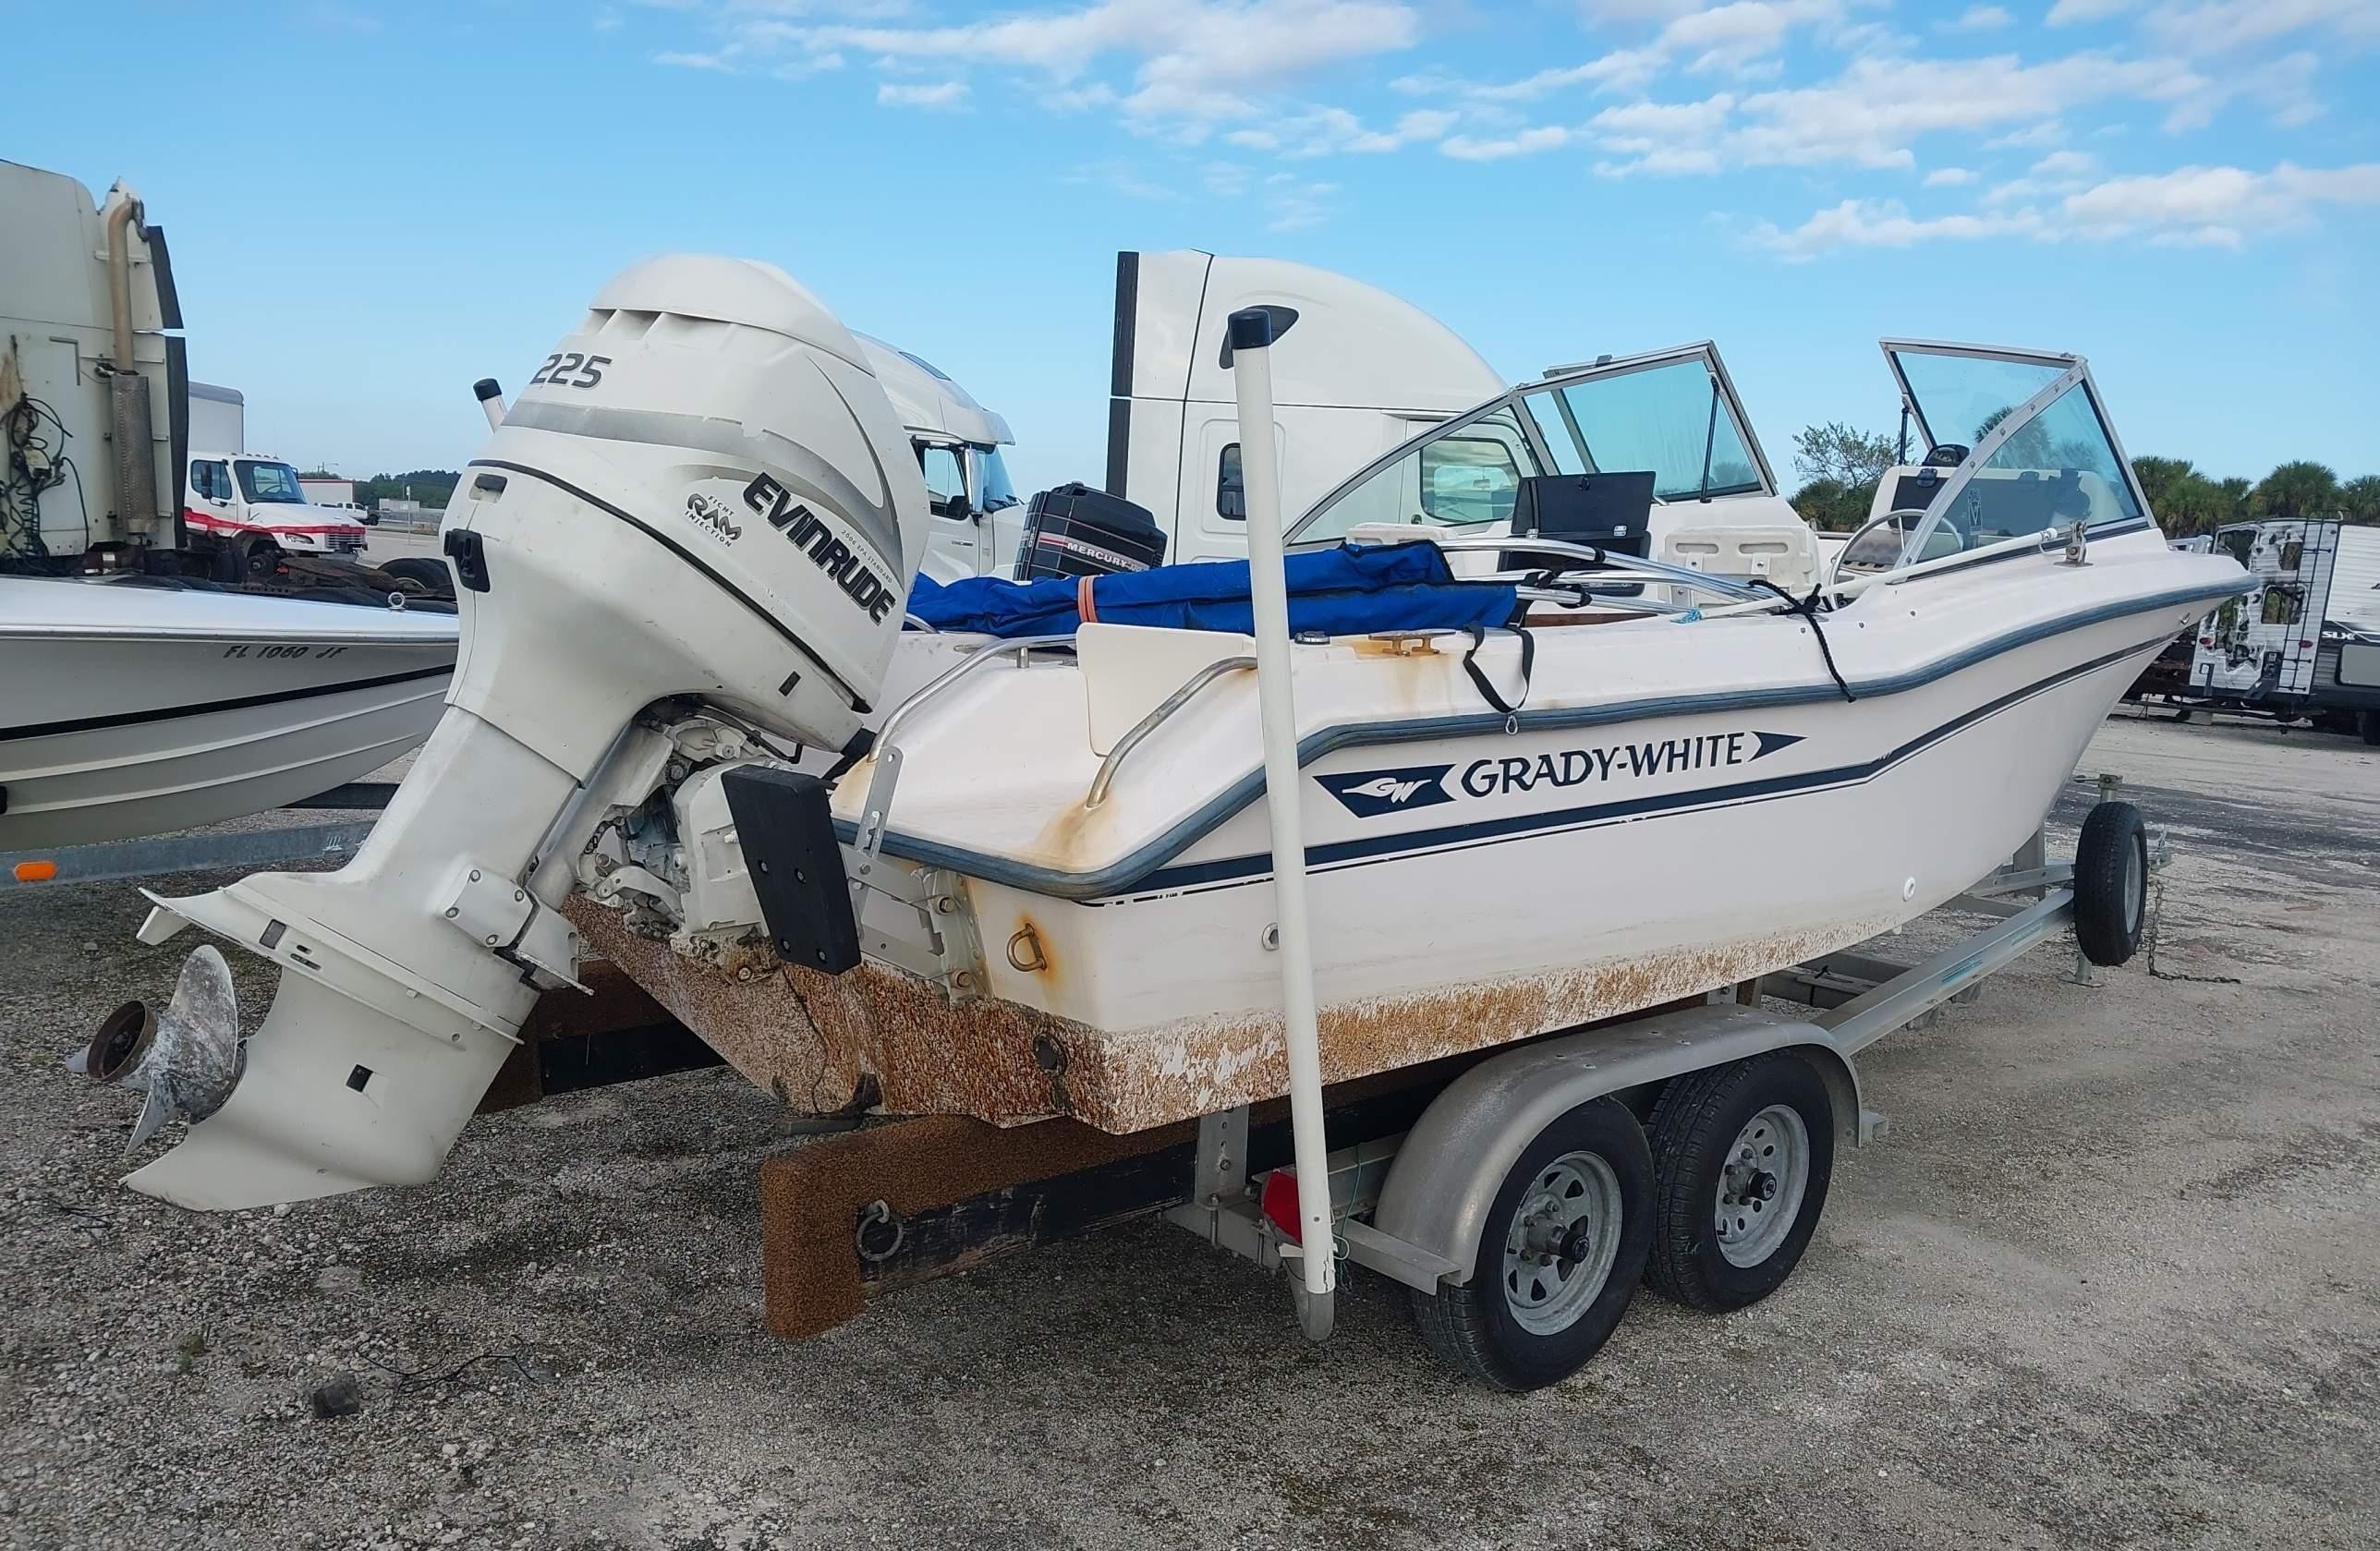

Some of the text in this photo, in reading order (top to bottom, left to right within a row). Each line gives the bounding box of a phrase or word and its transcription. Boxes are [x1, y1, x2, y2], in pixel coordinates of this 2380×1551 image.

[529, 352, 613, 389] 225
[684, 510, 733, 548] INJECTION
[686, 492, 743, 540] RAM
[743, 472, 896, 627] EVINRUDE
[841, 529, 893, 584] 2006 EPA STANDARD
[1067, 542, 1129, 568] MERCURY
[223, 645, 348, 659] FL 1060 JF
[1461, 732, 1745, 798] GRADY-WHITE
